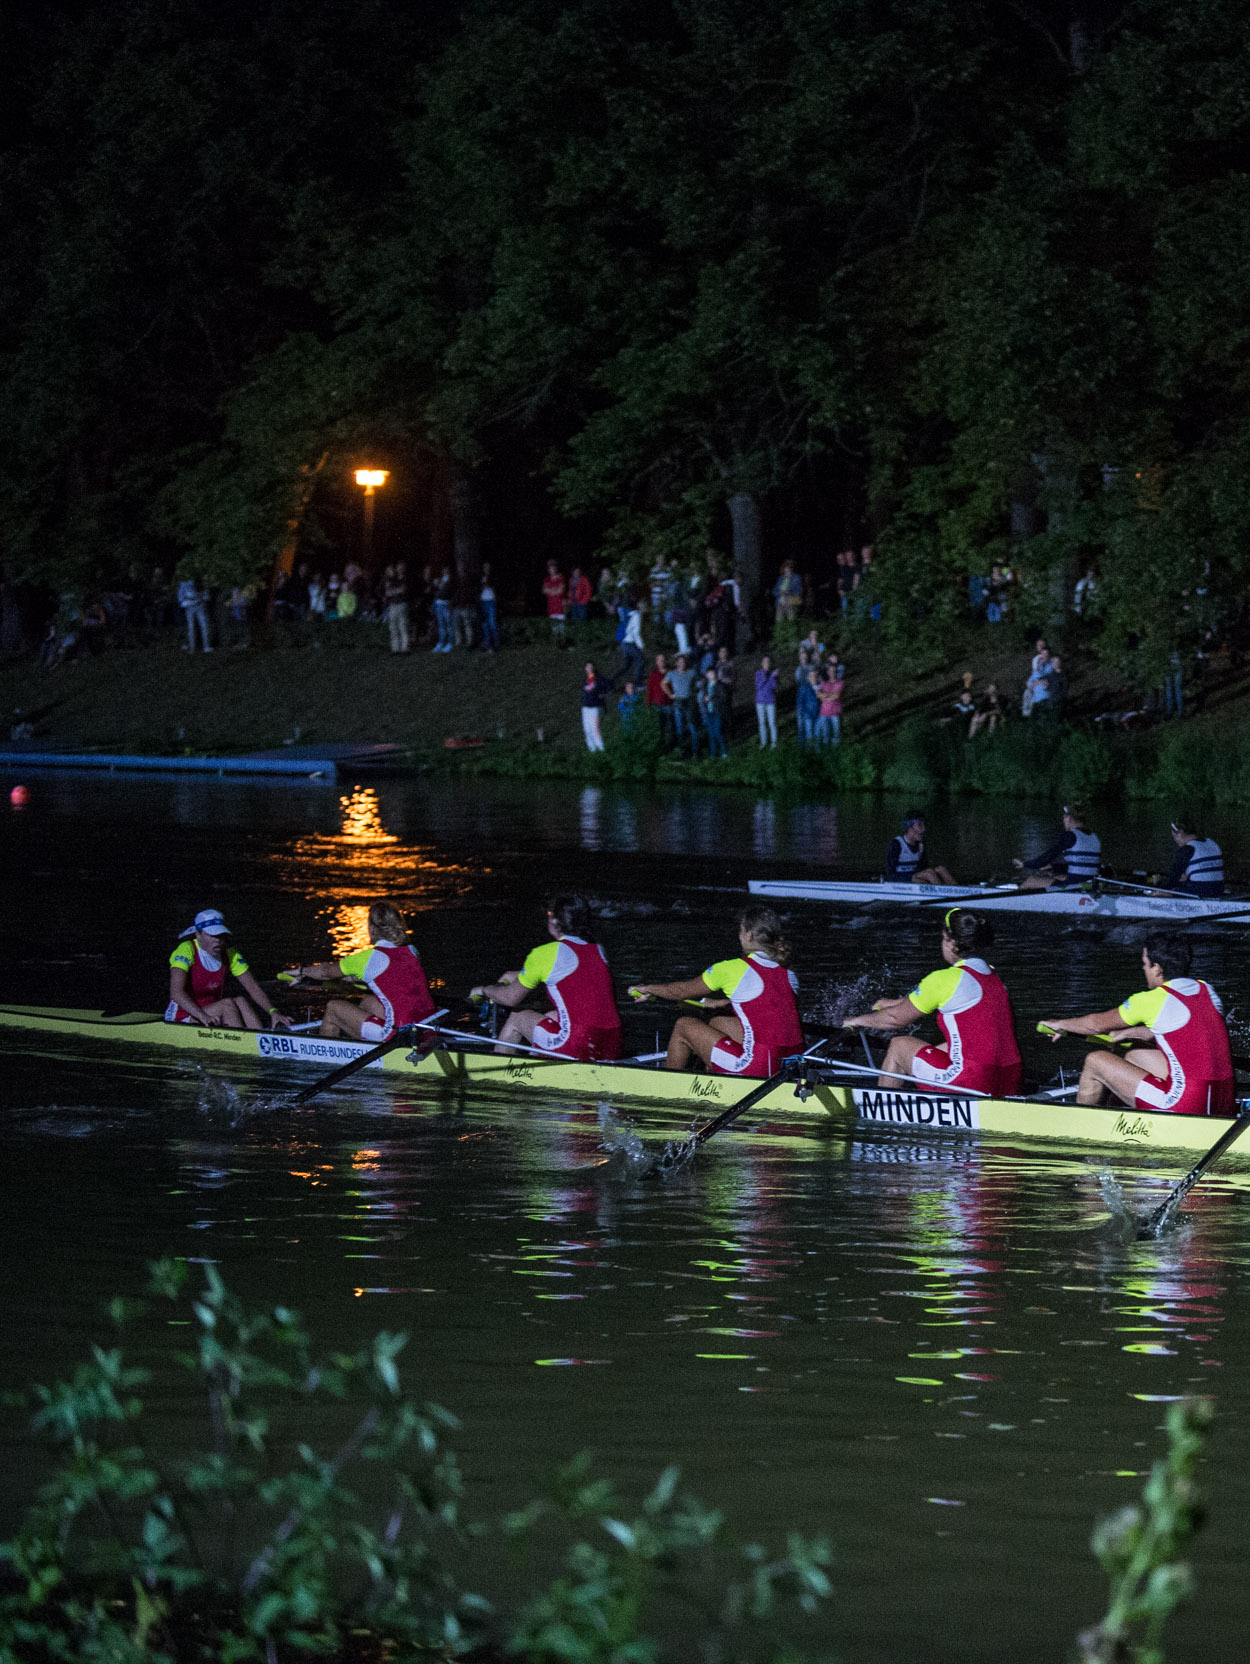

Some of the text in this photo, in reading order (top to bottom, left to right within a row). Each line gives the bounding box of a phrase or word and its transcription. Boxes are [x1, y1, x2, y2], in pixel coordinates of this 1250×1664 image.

[272, 1038, 298, 1054] RBL
[503, 1058, 533, 1080] Melitta
[688, 1076, 722, 1099] Melitta
[861, 1091, 974, 1128] MINDEN
[1112, 1113, 1151, 1137] Melitta
